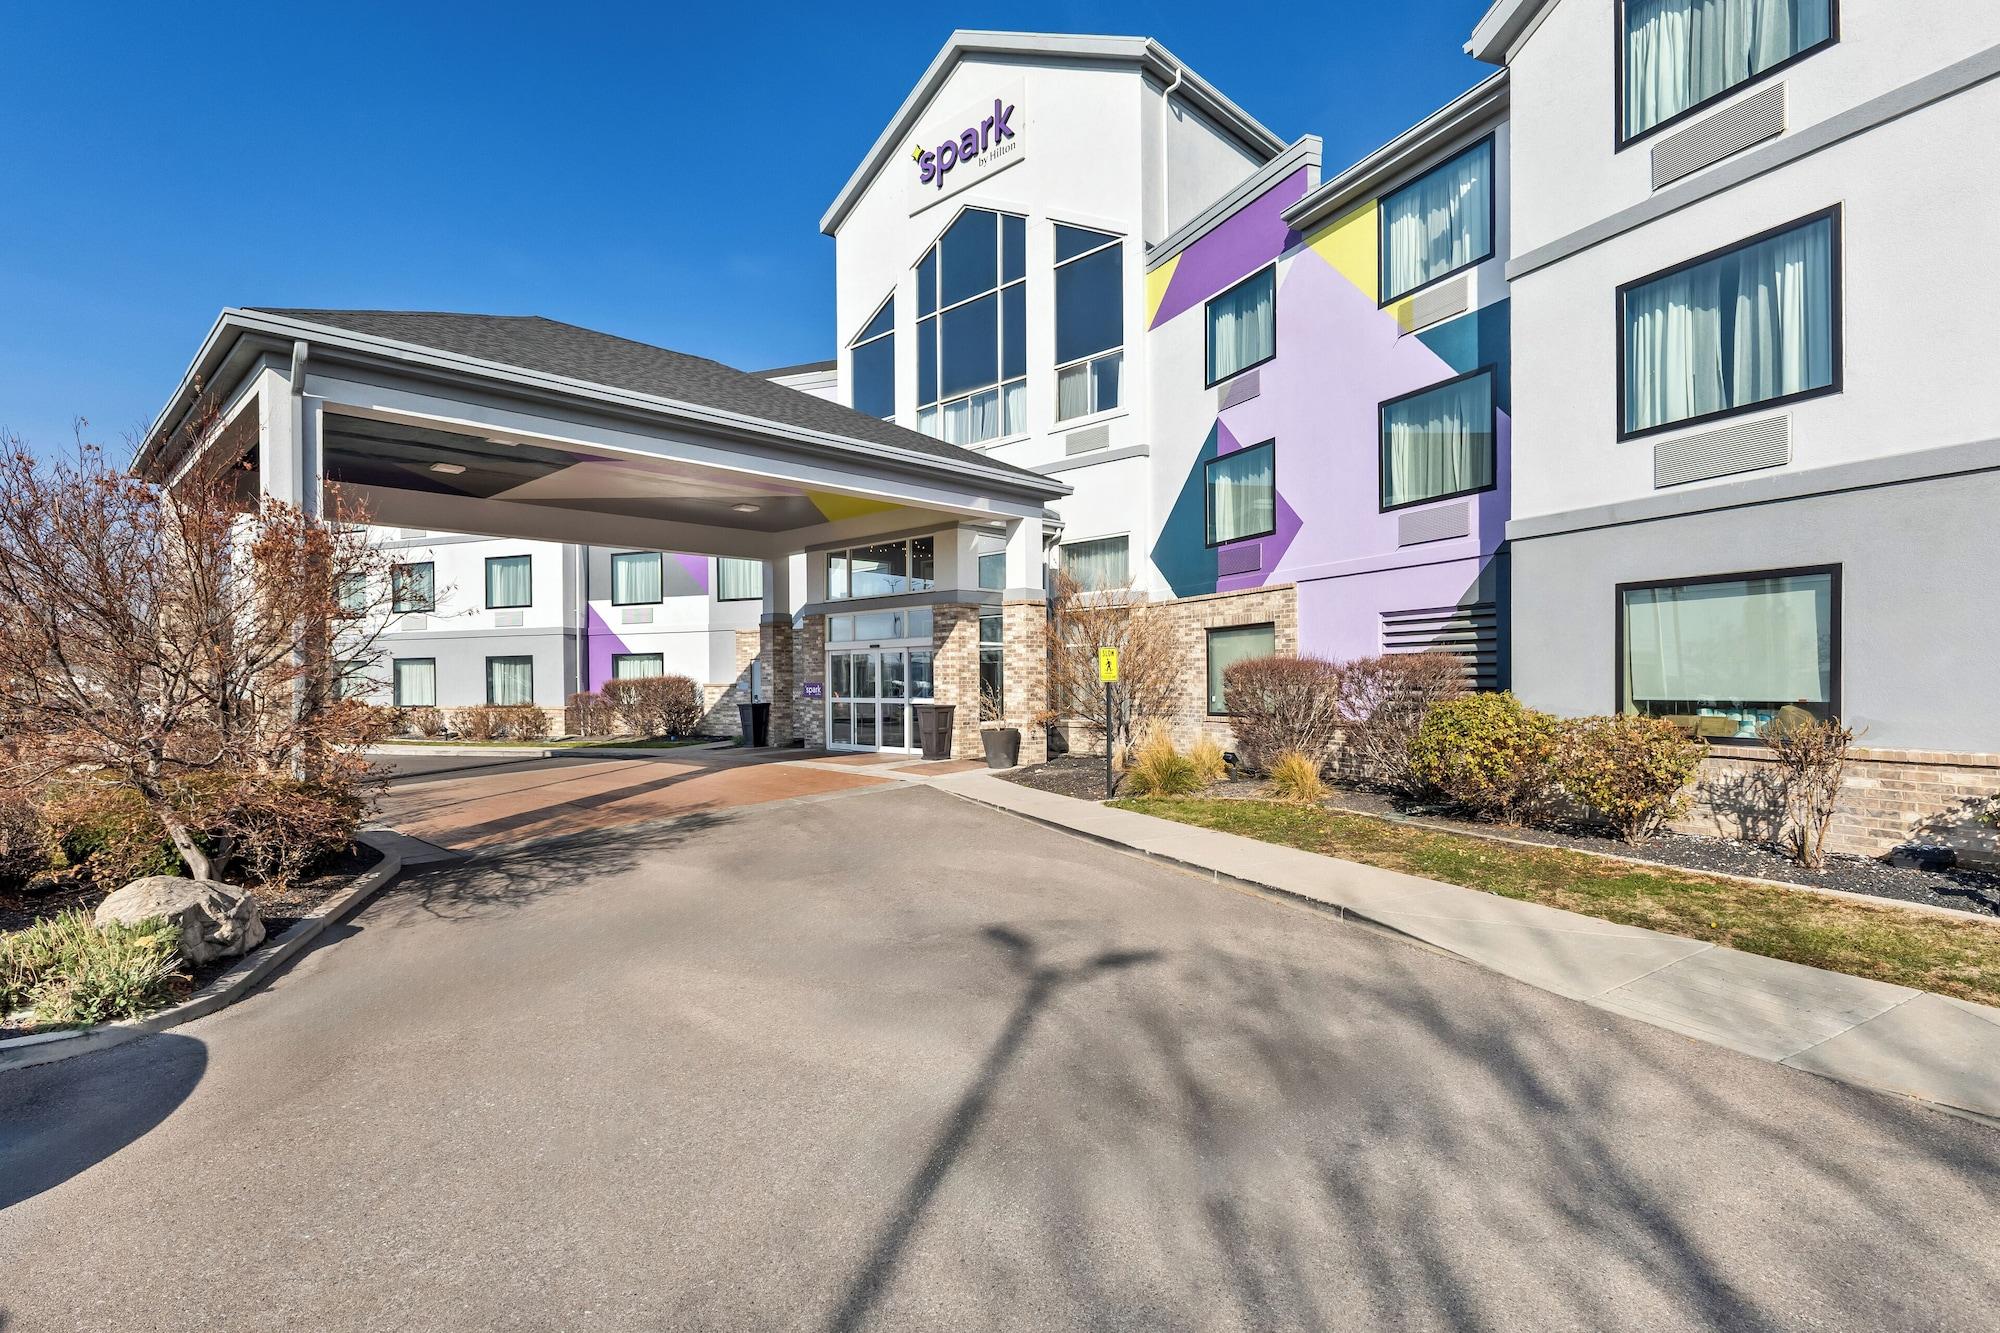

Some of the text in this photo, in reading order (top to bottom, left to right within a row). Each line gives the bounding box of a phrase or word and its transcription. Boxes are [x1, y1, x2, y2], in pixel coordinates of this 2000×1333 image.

[920, 99, 1015, 190] spark
[978, 142, 1016, 168] by Hilton
[805, 685, 821, 695] spark
